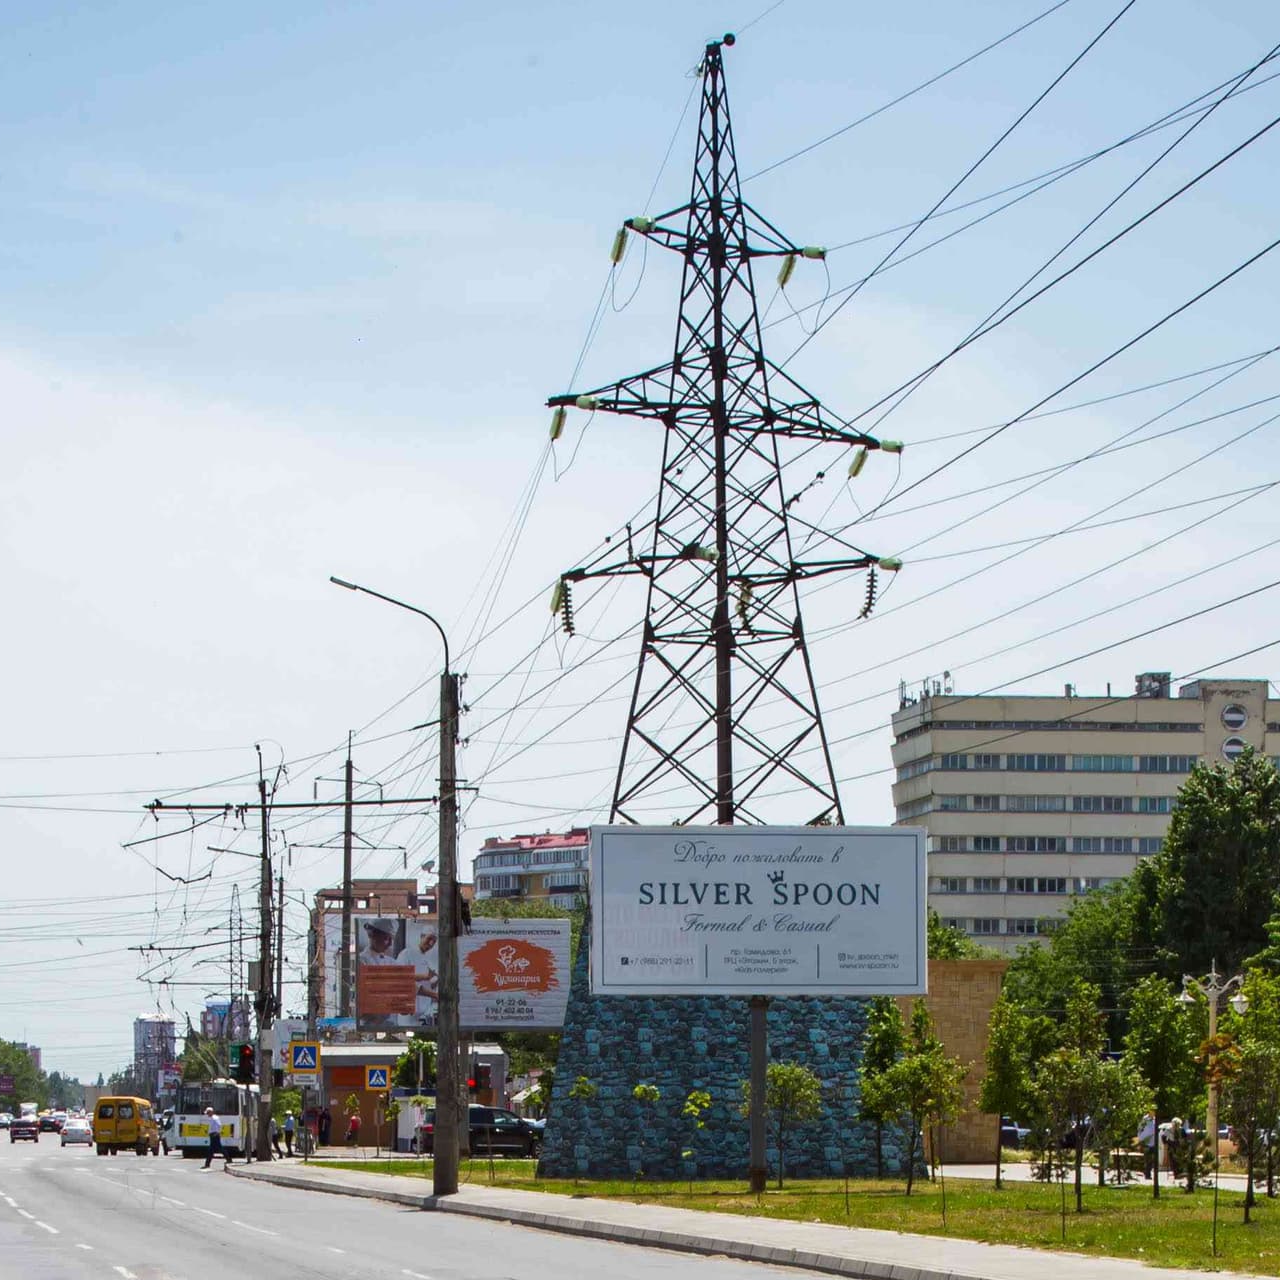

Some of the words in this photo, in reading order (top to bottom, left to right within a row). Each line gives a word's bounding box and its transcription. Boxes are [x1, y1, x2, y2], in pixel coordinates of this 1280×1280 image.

[673, 840, 726, 869] Добро
[733, 845, 824, 864] пожаловать
[831, 845, 845, 863] в
[638, 882, 754, 906] SILVER
[772, 882, 881, 906] SPOON
[679, 913, 752, 933] Formal
[752, 916, 768, 933] &
[771, 913, 841, 933] Casual
[492, 972, 541, 988] Кулинария
